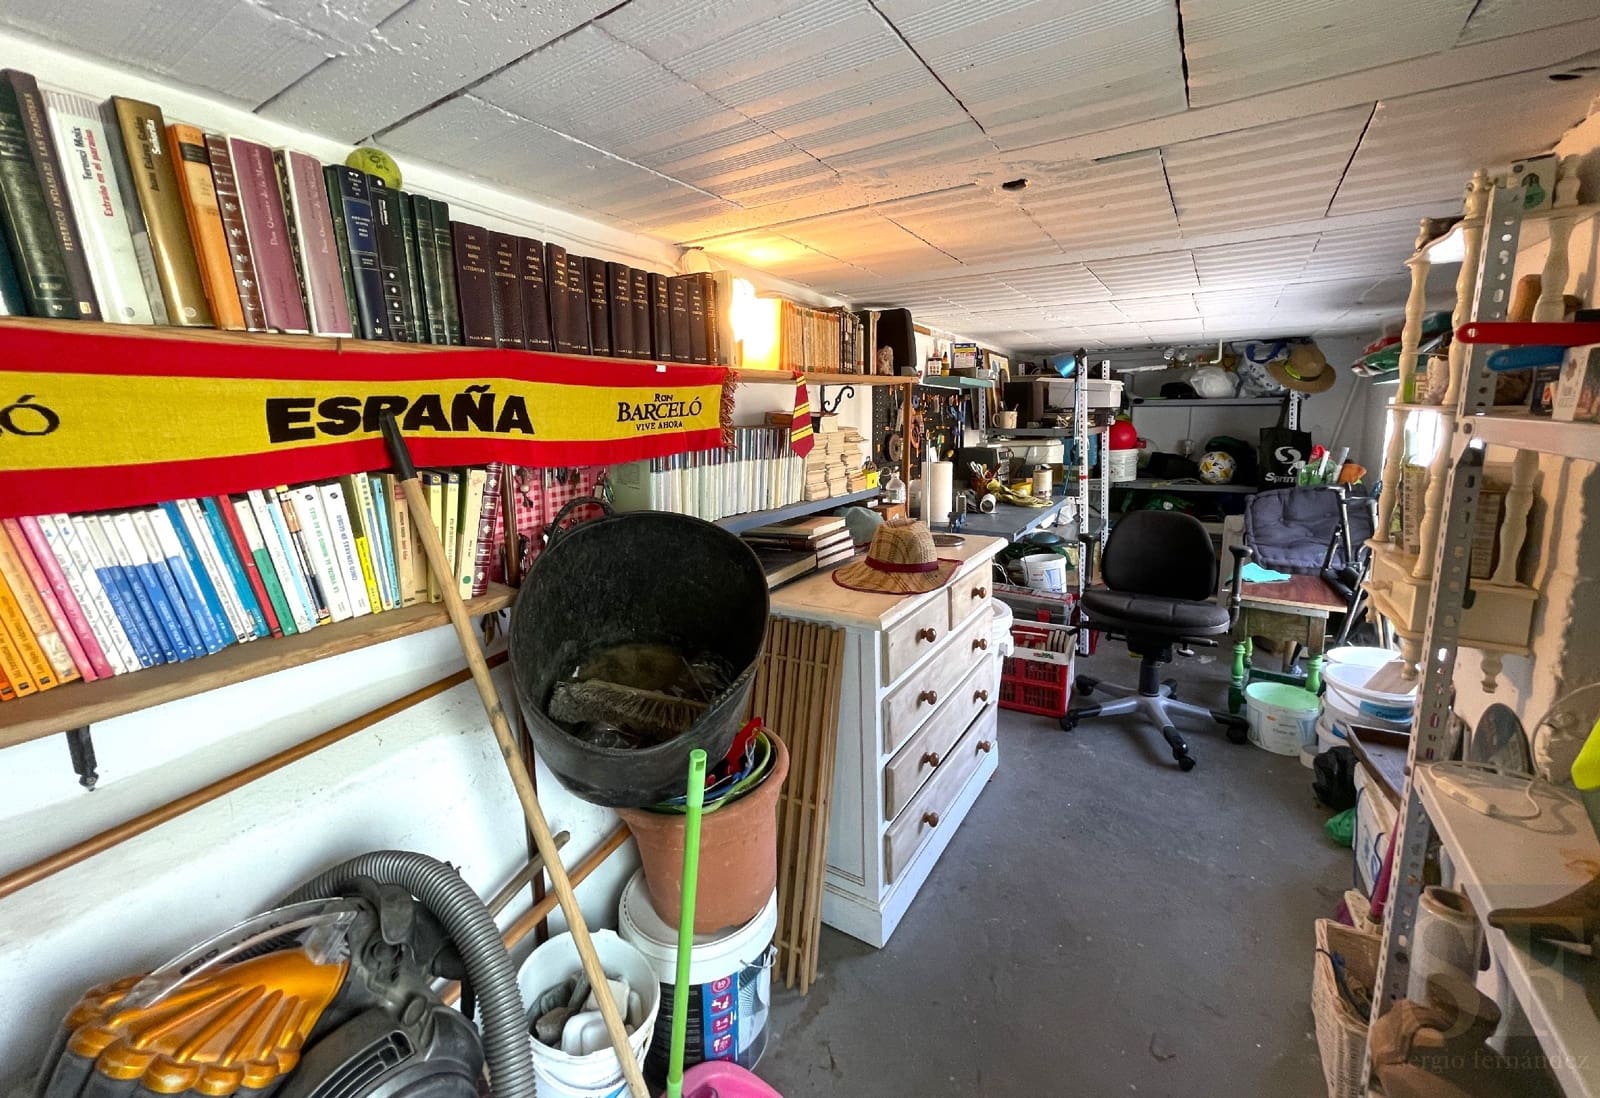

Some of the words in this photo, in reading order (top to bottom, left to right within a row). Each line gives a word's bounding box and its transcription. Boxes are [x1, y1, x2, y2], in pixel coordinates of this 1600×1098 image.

[71, 126, 82, 150] Moix
[77, 148, 93, 180] Terenci
[94, 161, 102, 171] el
[96, 173, 105, 184] en
[56, 208, 73, 251] FEDERICO
[266, 384, 536, 443] ESPAÑA
[616, 396, 703, 422] BARCELÓ
[636, 422, 656, 431] VIVE
[658, 420, 683, 430] AHORA
